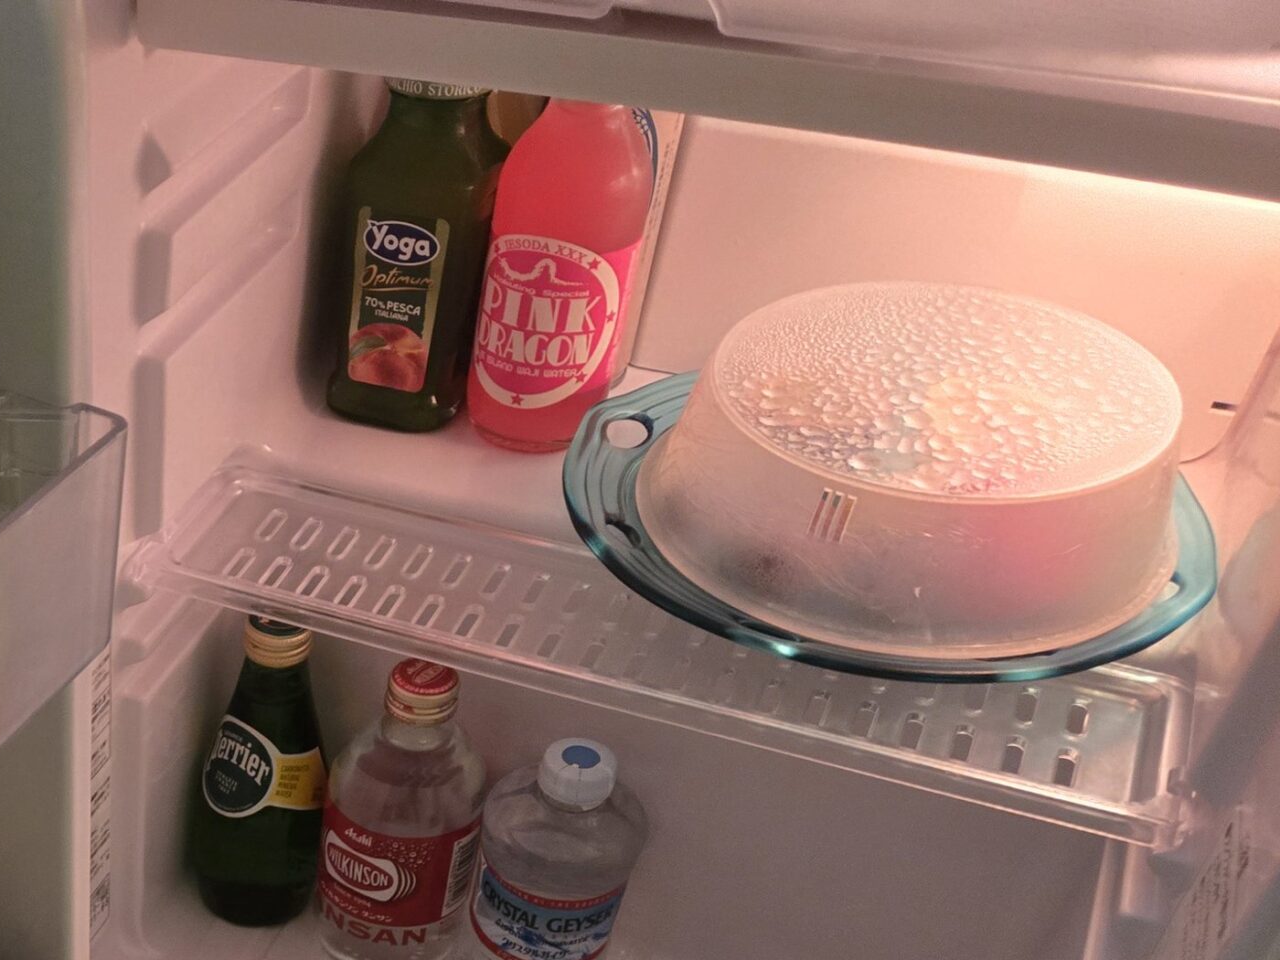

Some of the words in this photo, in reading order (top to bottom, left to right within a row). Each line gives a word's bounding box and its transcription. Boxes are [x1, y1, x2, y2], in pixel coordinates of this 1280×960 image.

[370, 223, 431, 261] Yoga
[360, 264, 435, 288] Optimum
[386, 299, 421, 317] PESCA
[483, 276, 602, 333] PINK
[478, 312, 596, 366] DRAGON
[344, 827, 372, 847] Asahi
[328, 846, 389, 887] WILKINSON
[317, 893, 428, 947] NSAN
[482, 880, 540, 930] CRYSTAL
[545, 906, 613, 933] GEYSER
